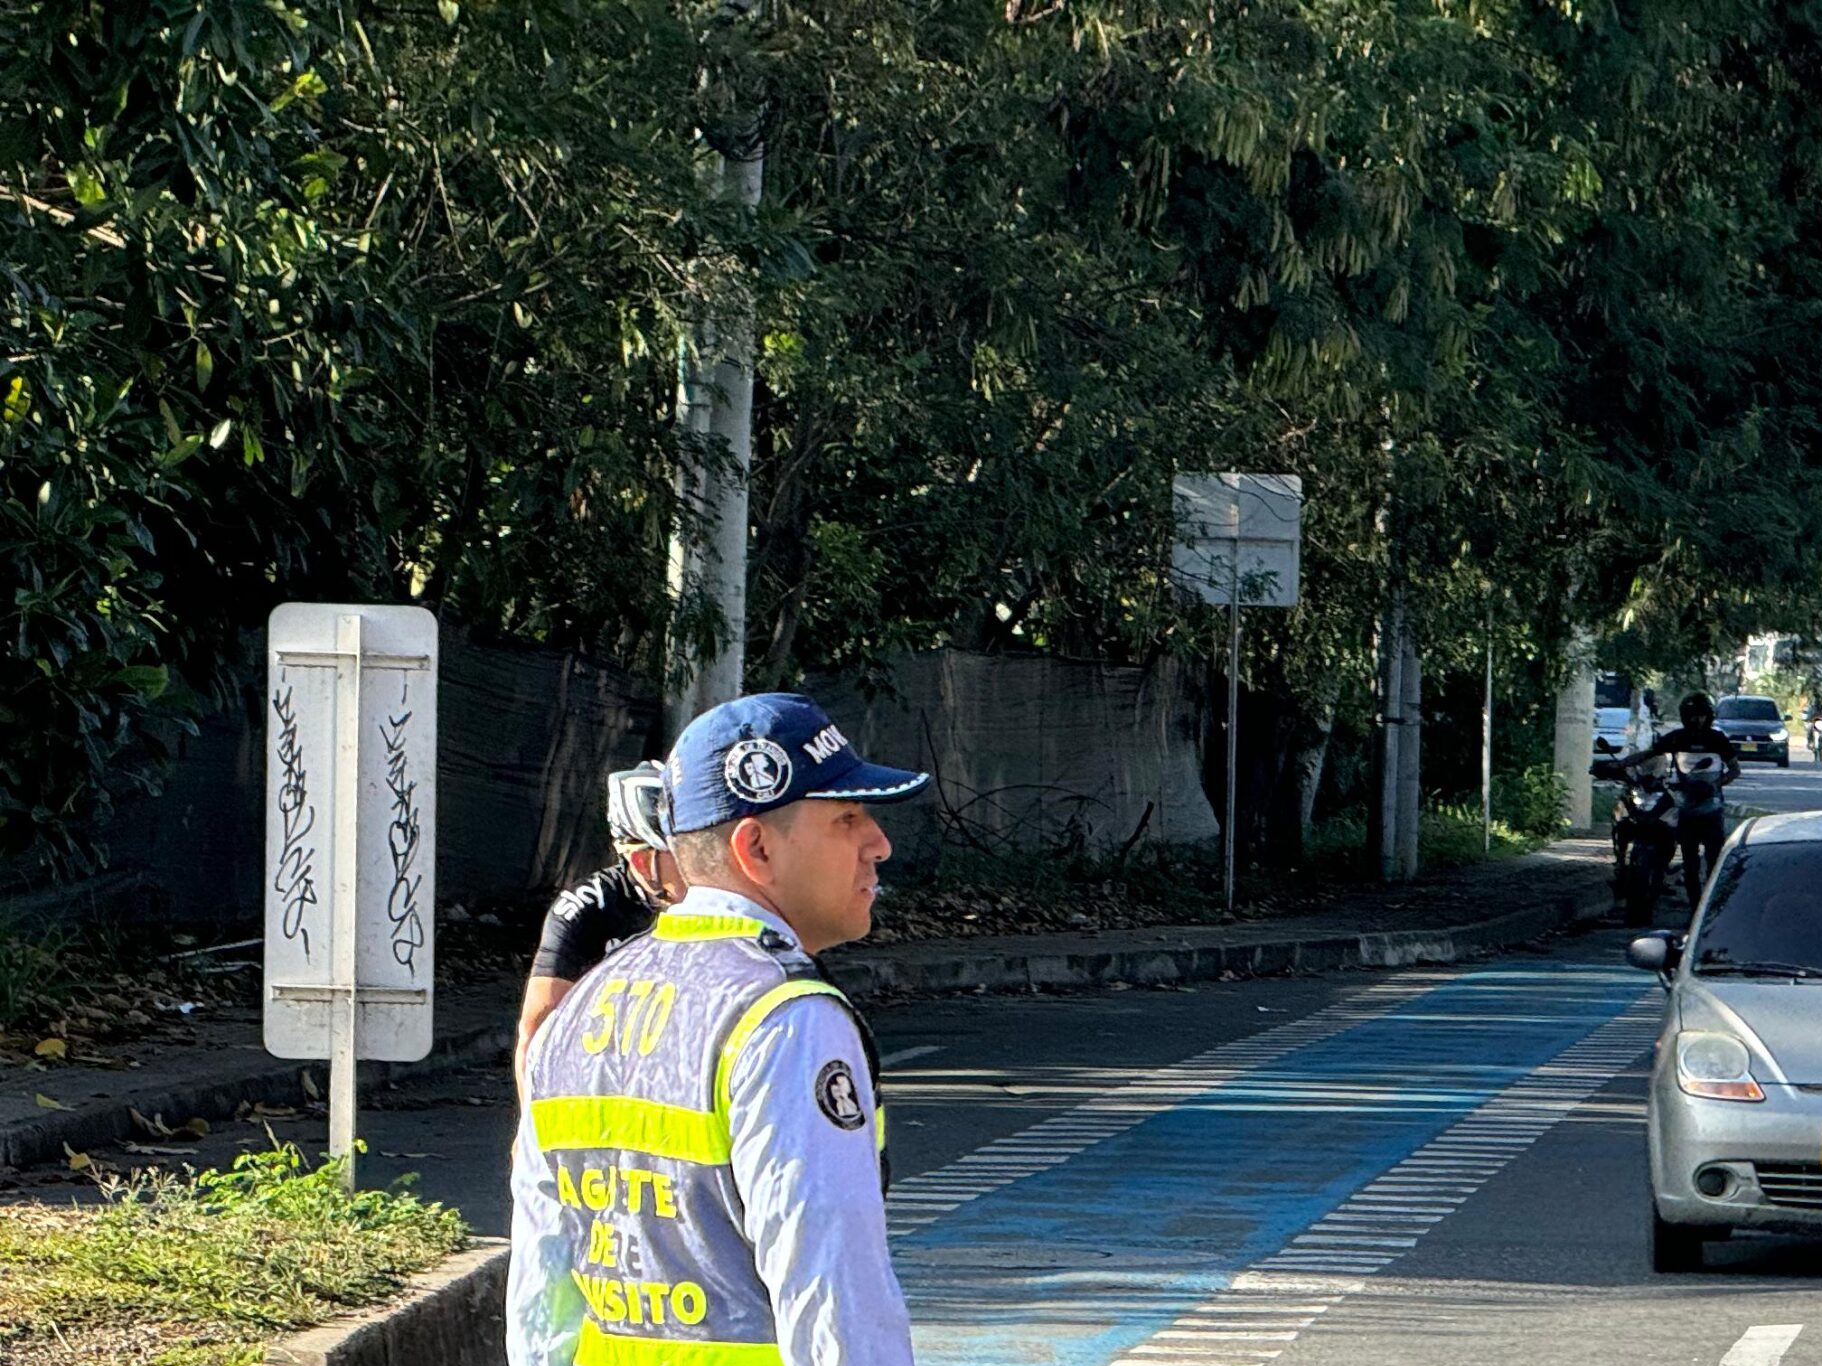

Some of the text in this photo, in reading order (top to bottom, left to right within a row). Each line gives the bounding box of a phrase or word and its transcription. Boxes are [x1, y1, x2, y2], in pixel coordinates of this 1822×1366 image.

[553, 877, 605, 921] sky
[581, 978, 676, 1057] 570
[588, 1219, 618, 1268] DE
